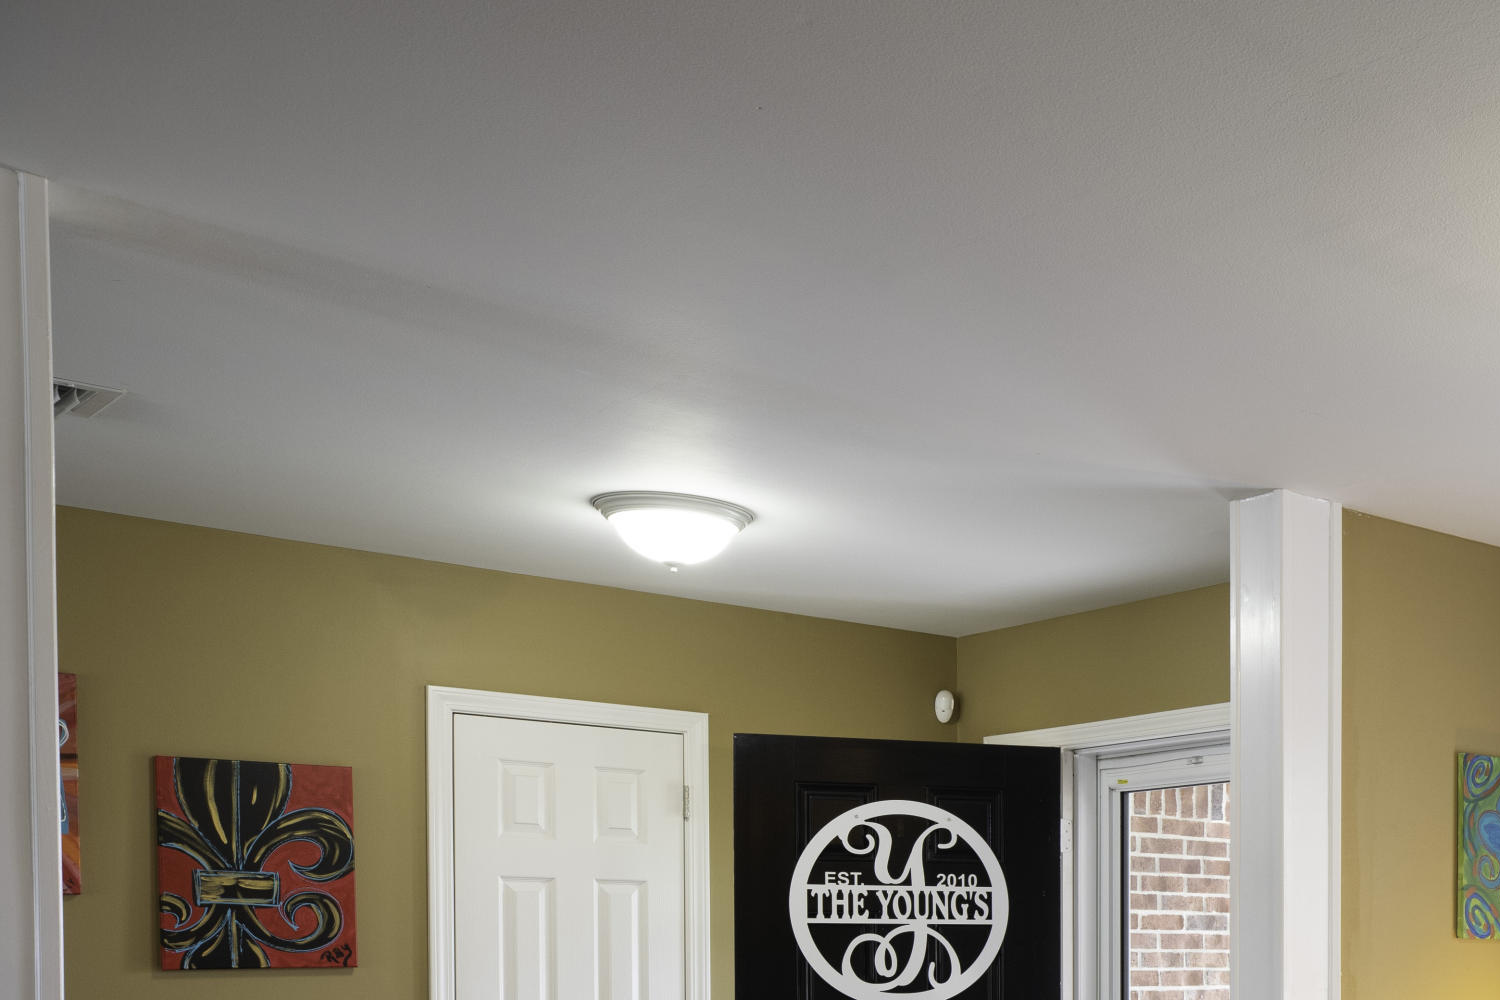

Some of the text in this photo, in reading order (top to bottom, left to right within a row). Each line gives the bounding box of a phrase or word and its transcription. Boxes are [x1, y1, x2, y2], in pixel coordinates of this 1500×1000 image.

[824, 871, 865, 886] EST.
[936, 873, 978, 888] 2010
[810, 888, 990, 921] THE YOUNG'S
